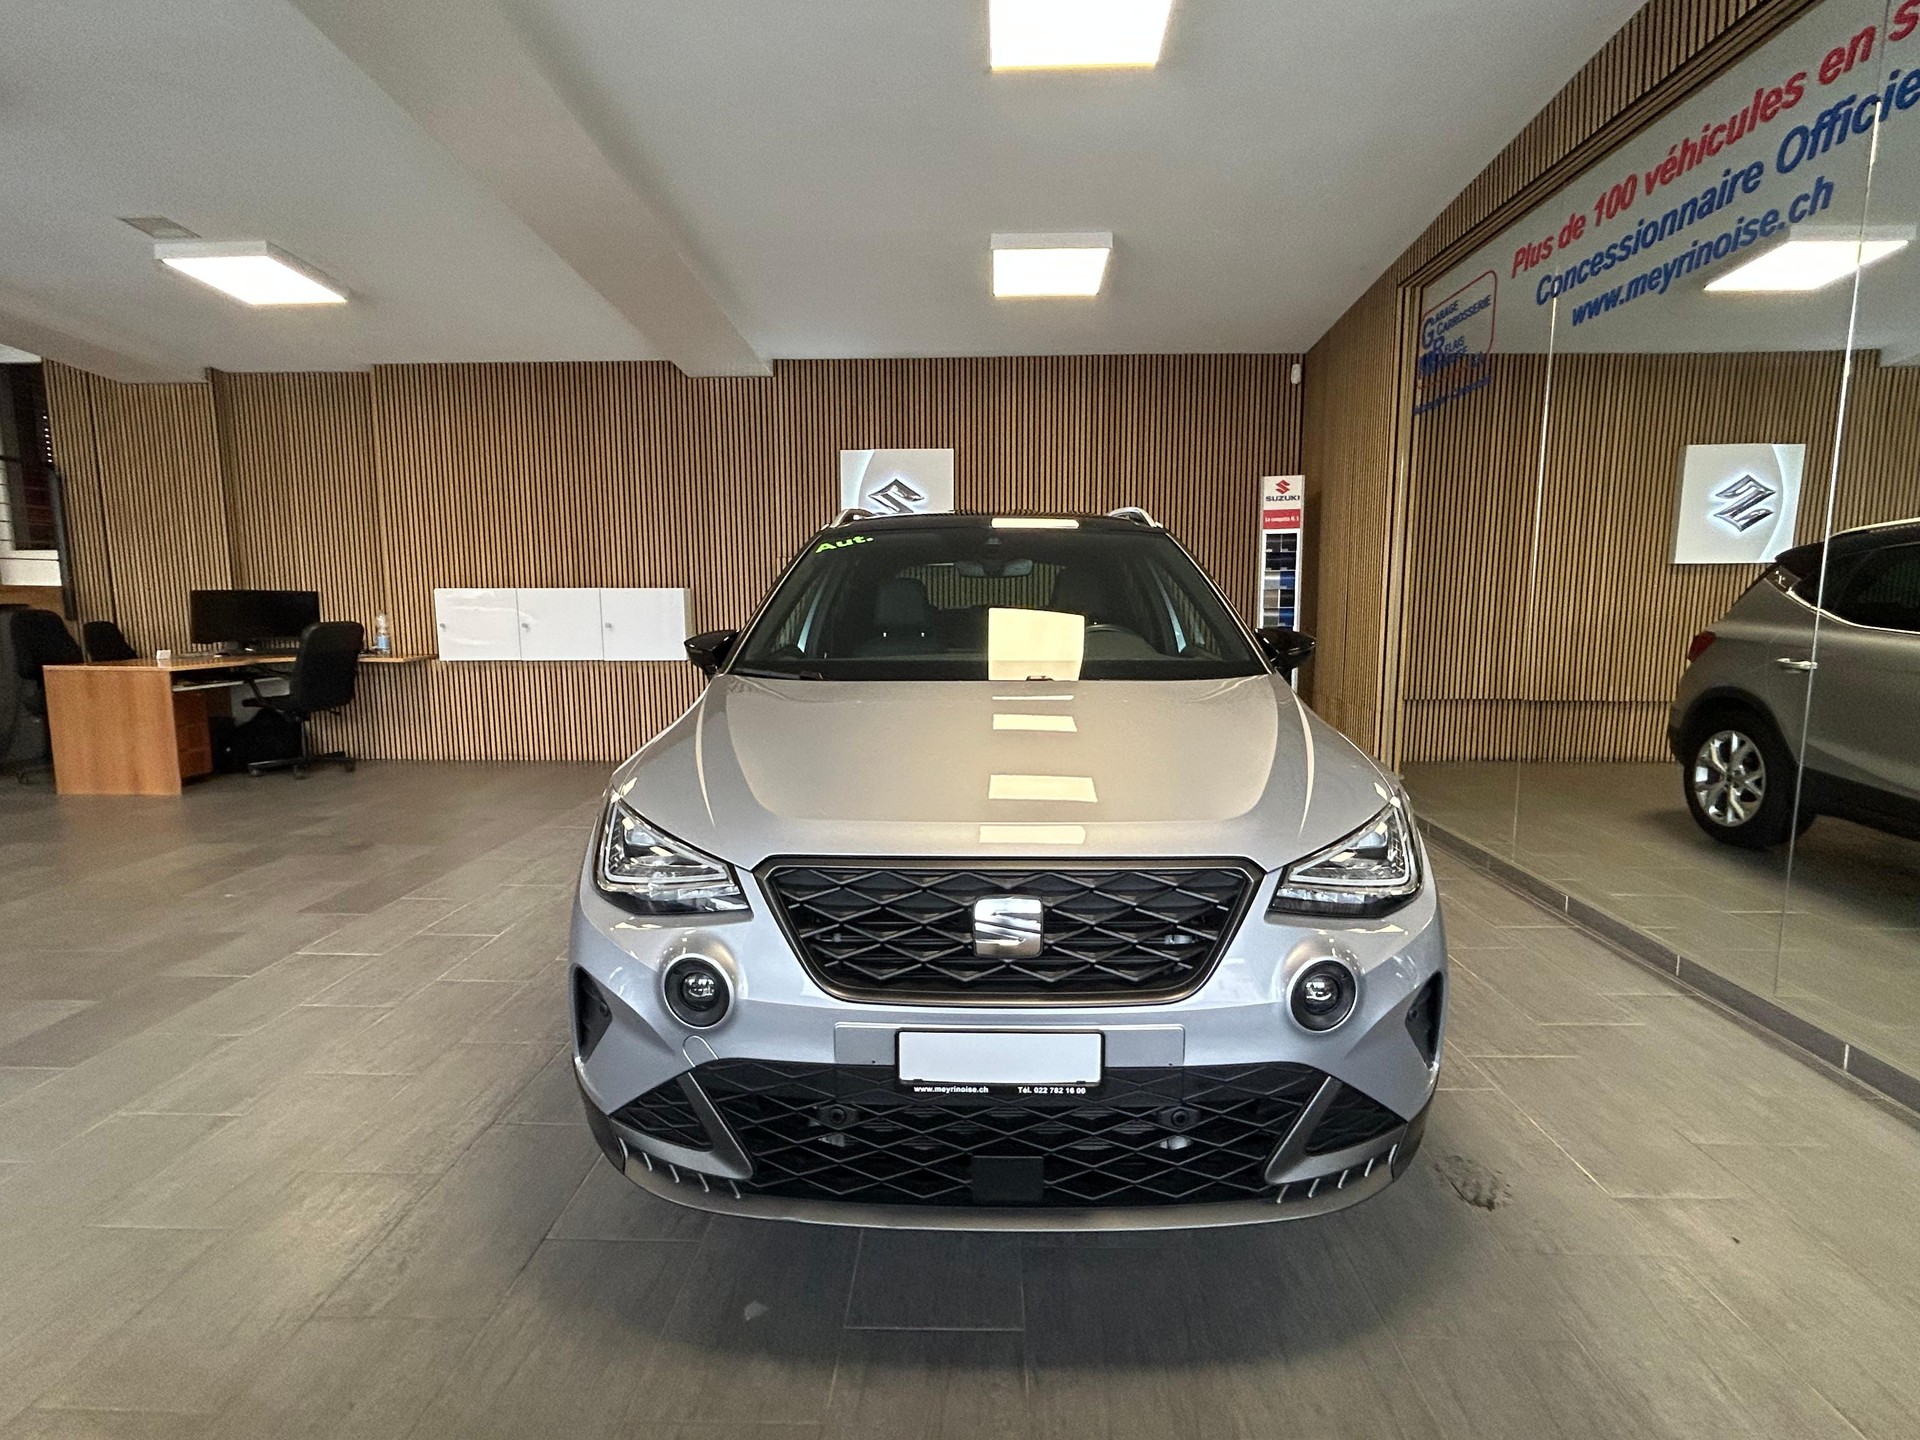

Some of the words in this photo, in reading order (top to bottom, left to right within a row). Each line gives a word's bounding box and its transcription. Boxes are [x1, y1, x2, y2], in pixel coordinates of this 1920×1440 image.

[1511, 235, 1555, 279] Plus
[1557, 213, 1586, 249] de
[1594, 174, 1638, 227] 100
[1644, 71, 1807, 196] véhicules
[1818, 25, 1877, 85] en
[1535, 161, 1765, 305] Concessionnaire
[1776, 69, 1920, 174] Officie
[1572, 175, 1834, 327] www.meyrinoise.ch
[815, 536, 874, 553] Aut.
[913, 1086, 989, 1094] www.meyrinoise.ch
